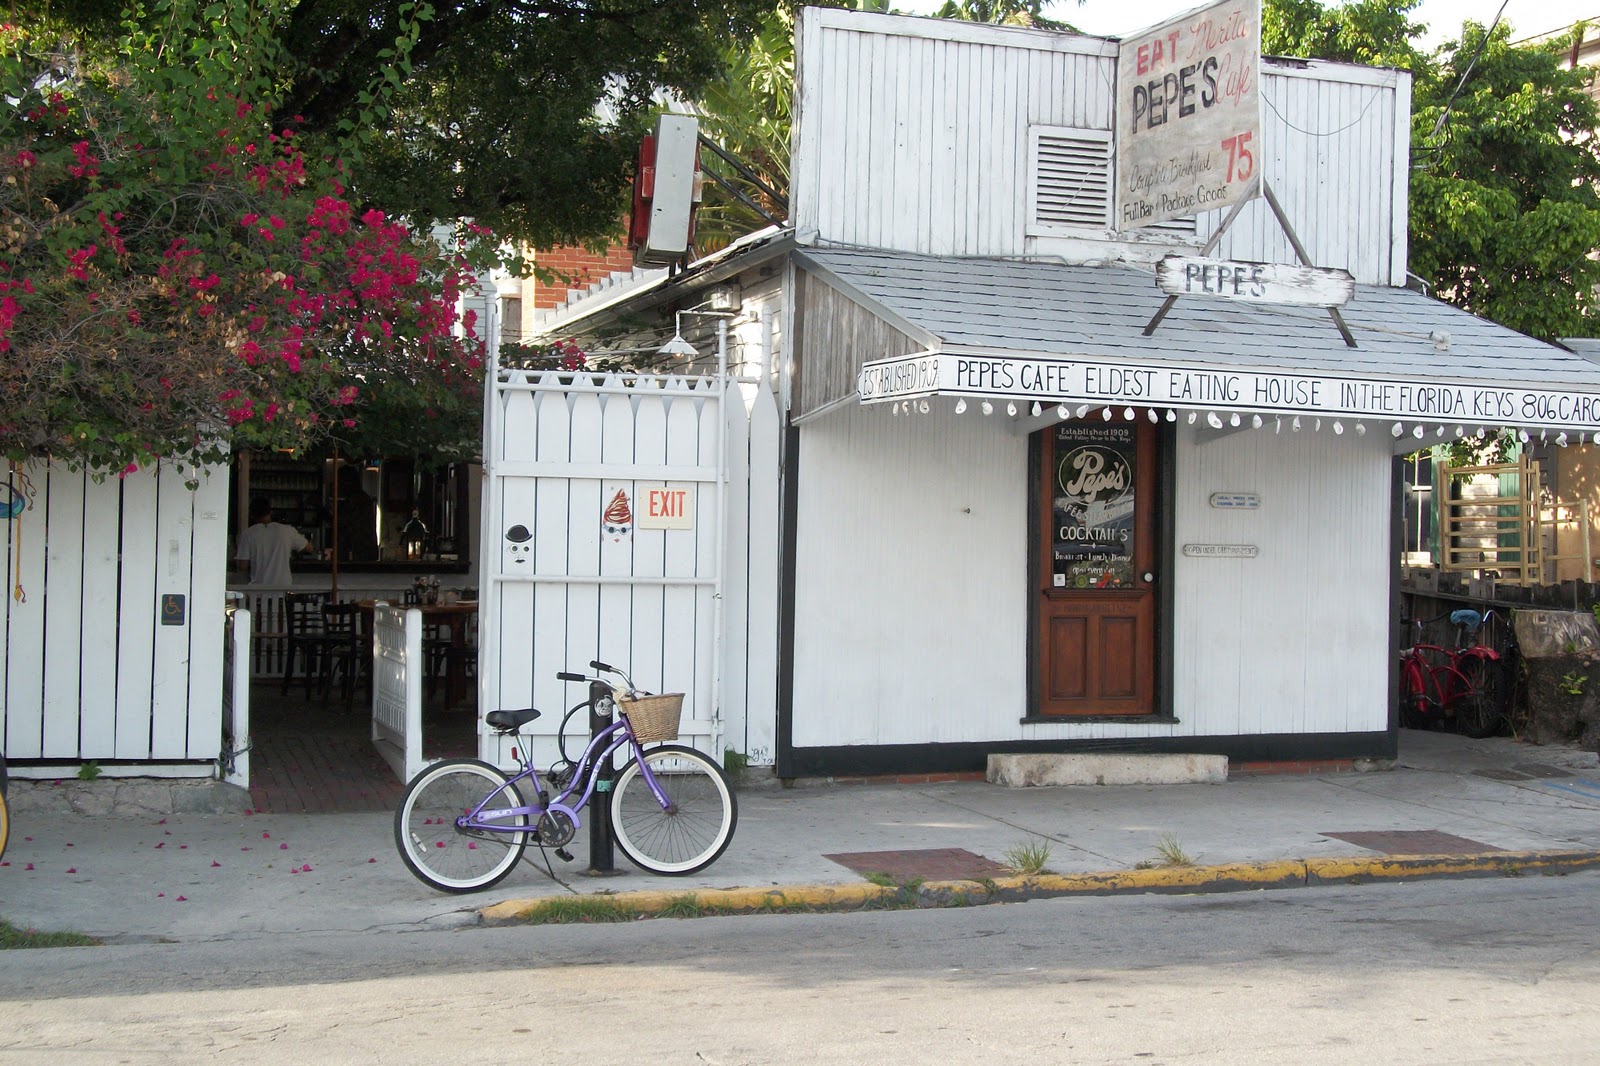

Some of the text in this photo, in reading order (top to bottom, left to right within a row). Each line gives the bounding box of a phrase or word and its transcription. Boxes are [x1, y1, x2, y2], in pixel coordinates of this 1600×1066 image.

[1137, 30, 1180, 76] EAT
[1132, 56, 1219, 134] PEPE'S
[1221, 131, 1253, 184] 75
[1140, 199, 1153, 218] Bar
[1161, 191, 1196, 213] Package
[1185, 263, 1266, 297] PEPES
[863, 359, 939, 396] ESTABLISHED 1909
[957, 359, 1014, 389] PEPE'S
[1085, 367, 1158, 397] ELDEST
[1169, 372, 1240, 401] EATING
[1254, 377, 1322, 406] HOUSE
[1400, 387, 1466, 415] FLORIDA
[1473, 390, 1514, 417] KEYS
[1521, 393, 1557, 420] 806
[1061, 427, 1129, 437] Established 1909
[1067, 450, 1125, 503] Pepe's
[649, 490, 687, 518] EXIT
